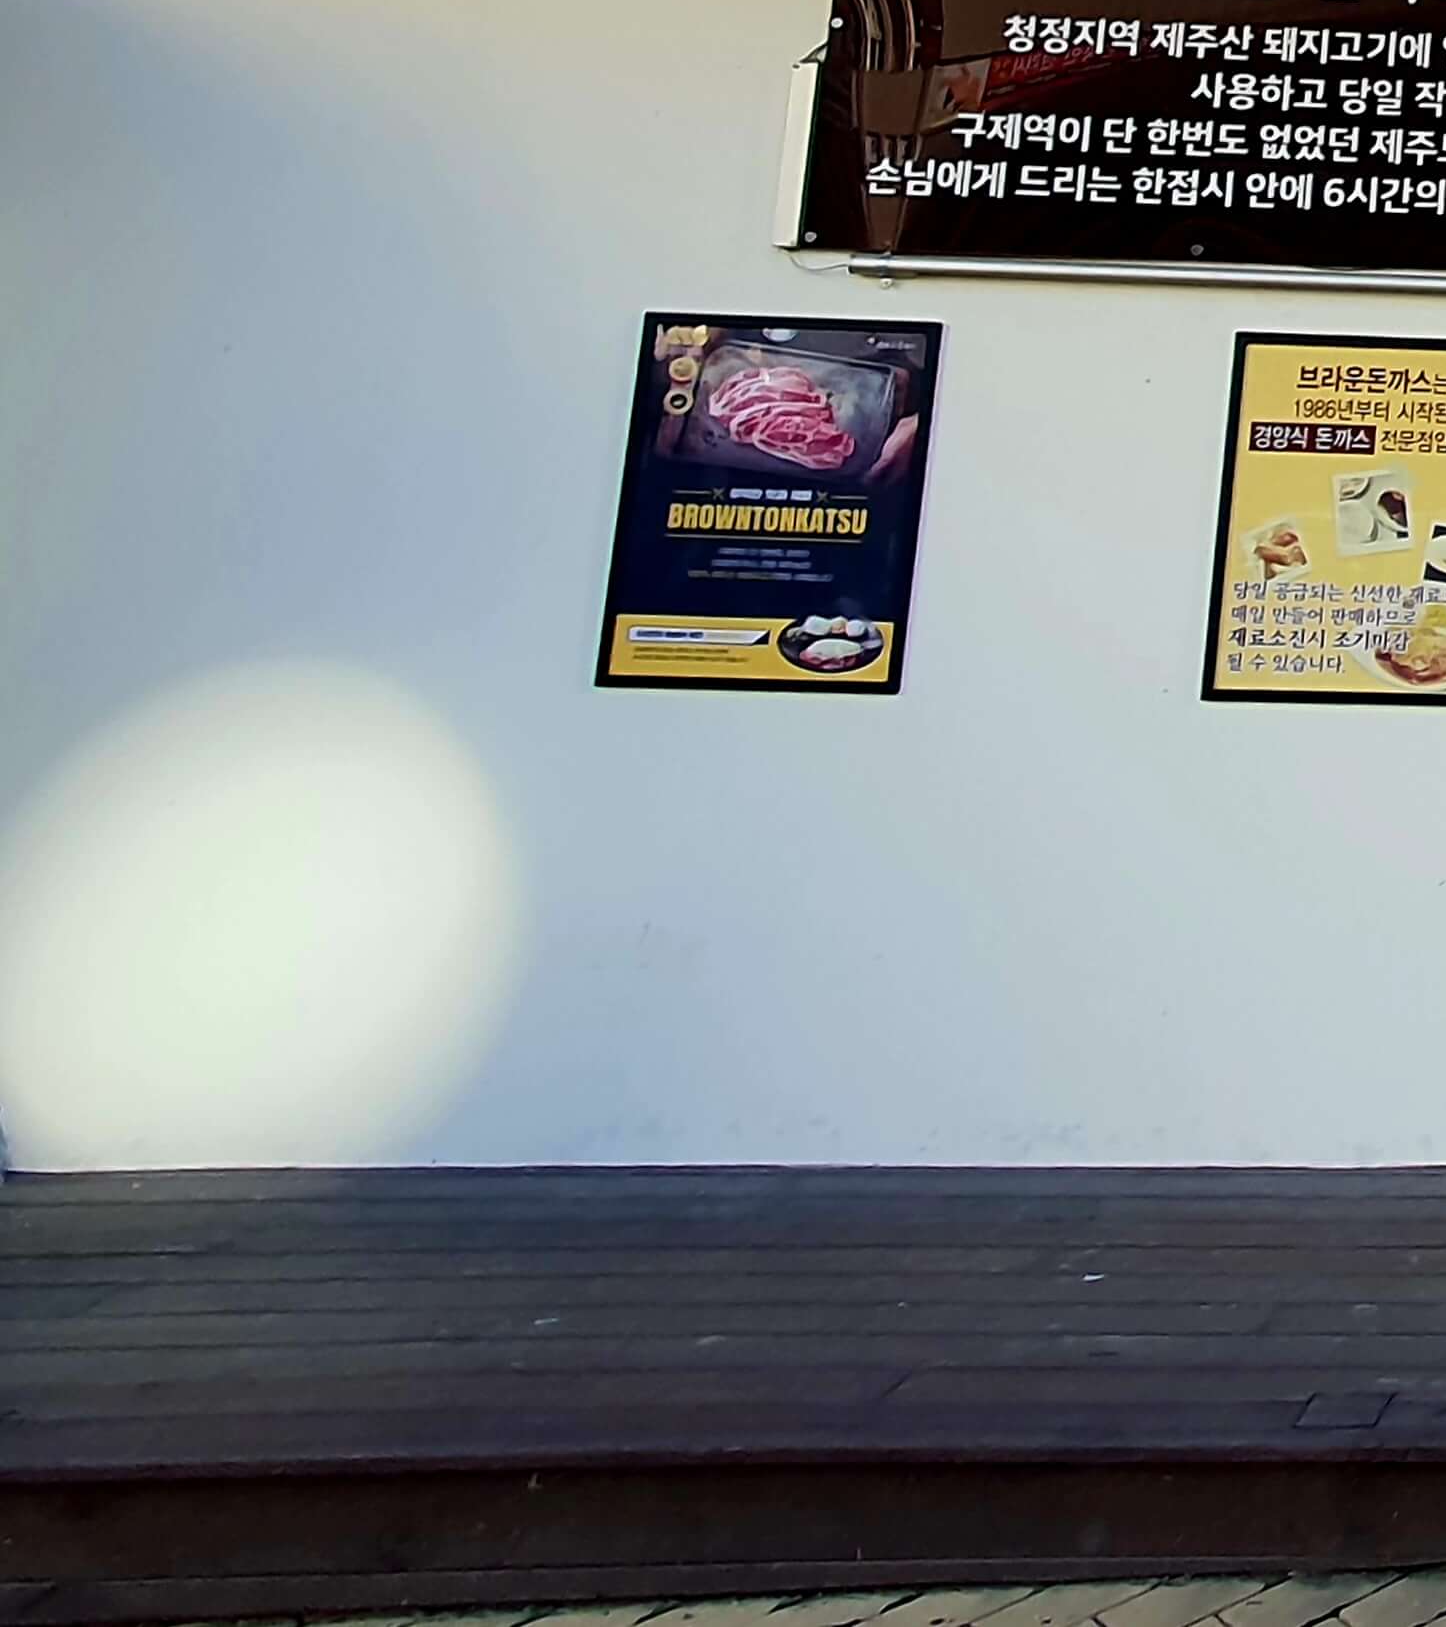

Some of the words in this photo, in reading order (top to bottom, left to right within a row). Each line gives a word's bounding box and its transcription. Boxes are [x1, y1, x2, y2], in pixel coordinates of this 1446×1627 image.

[1003, 14, 1140, 57] 청정지역
[1150, 21, 1255, 62] 제주산
[1262, 27, 1432, 70] 돼지고기에
[1190, 71, 1328, 112] 사용하고
[1338, 78, 1404, 117] 당일
[951, 111, 1091, 153] 구제역이
[1102, 116, 1138, 155] 단
[1146, 118, 1250, 159] 한번도
[1258, 124, 1360, 163] 없었던
[864, 156, 1008, 199] 손님에게
[1014, 163, 1122, 203] 드리는
[1132, 166, 1234, 208] 한접시
[1245, 171, 1313, 210] 안에
[1322, 176, 1446, 216] 6시간의
[1294, 398, 1391, 423] 1986년부터
[1253, 425, 1309, 450] 경양식
[1314, 427, 1372, 451] 돈까스
[666, 502, 869, 535] BROWNTONKATSU
[1274, 582, 1344, 603] 공급되는
[1228, 627, 1326, 650] 재료소진시
[1332, 629, 1411, 652] 조기마감
[1247, 654, 1267, 672] 수
[1272, 653, 1346, 675] 있습니다.
